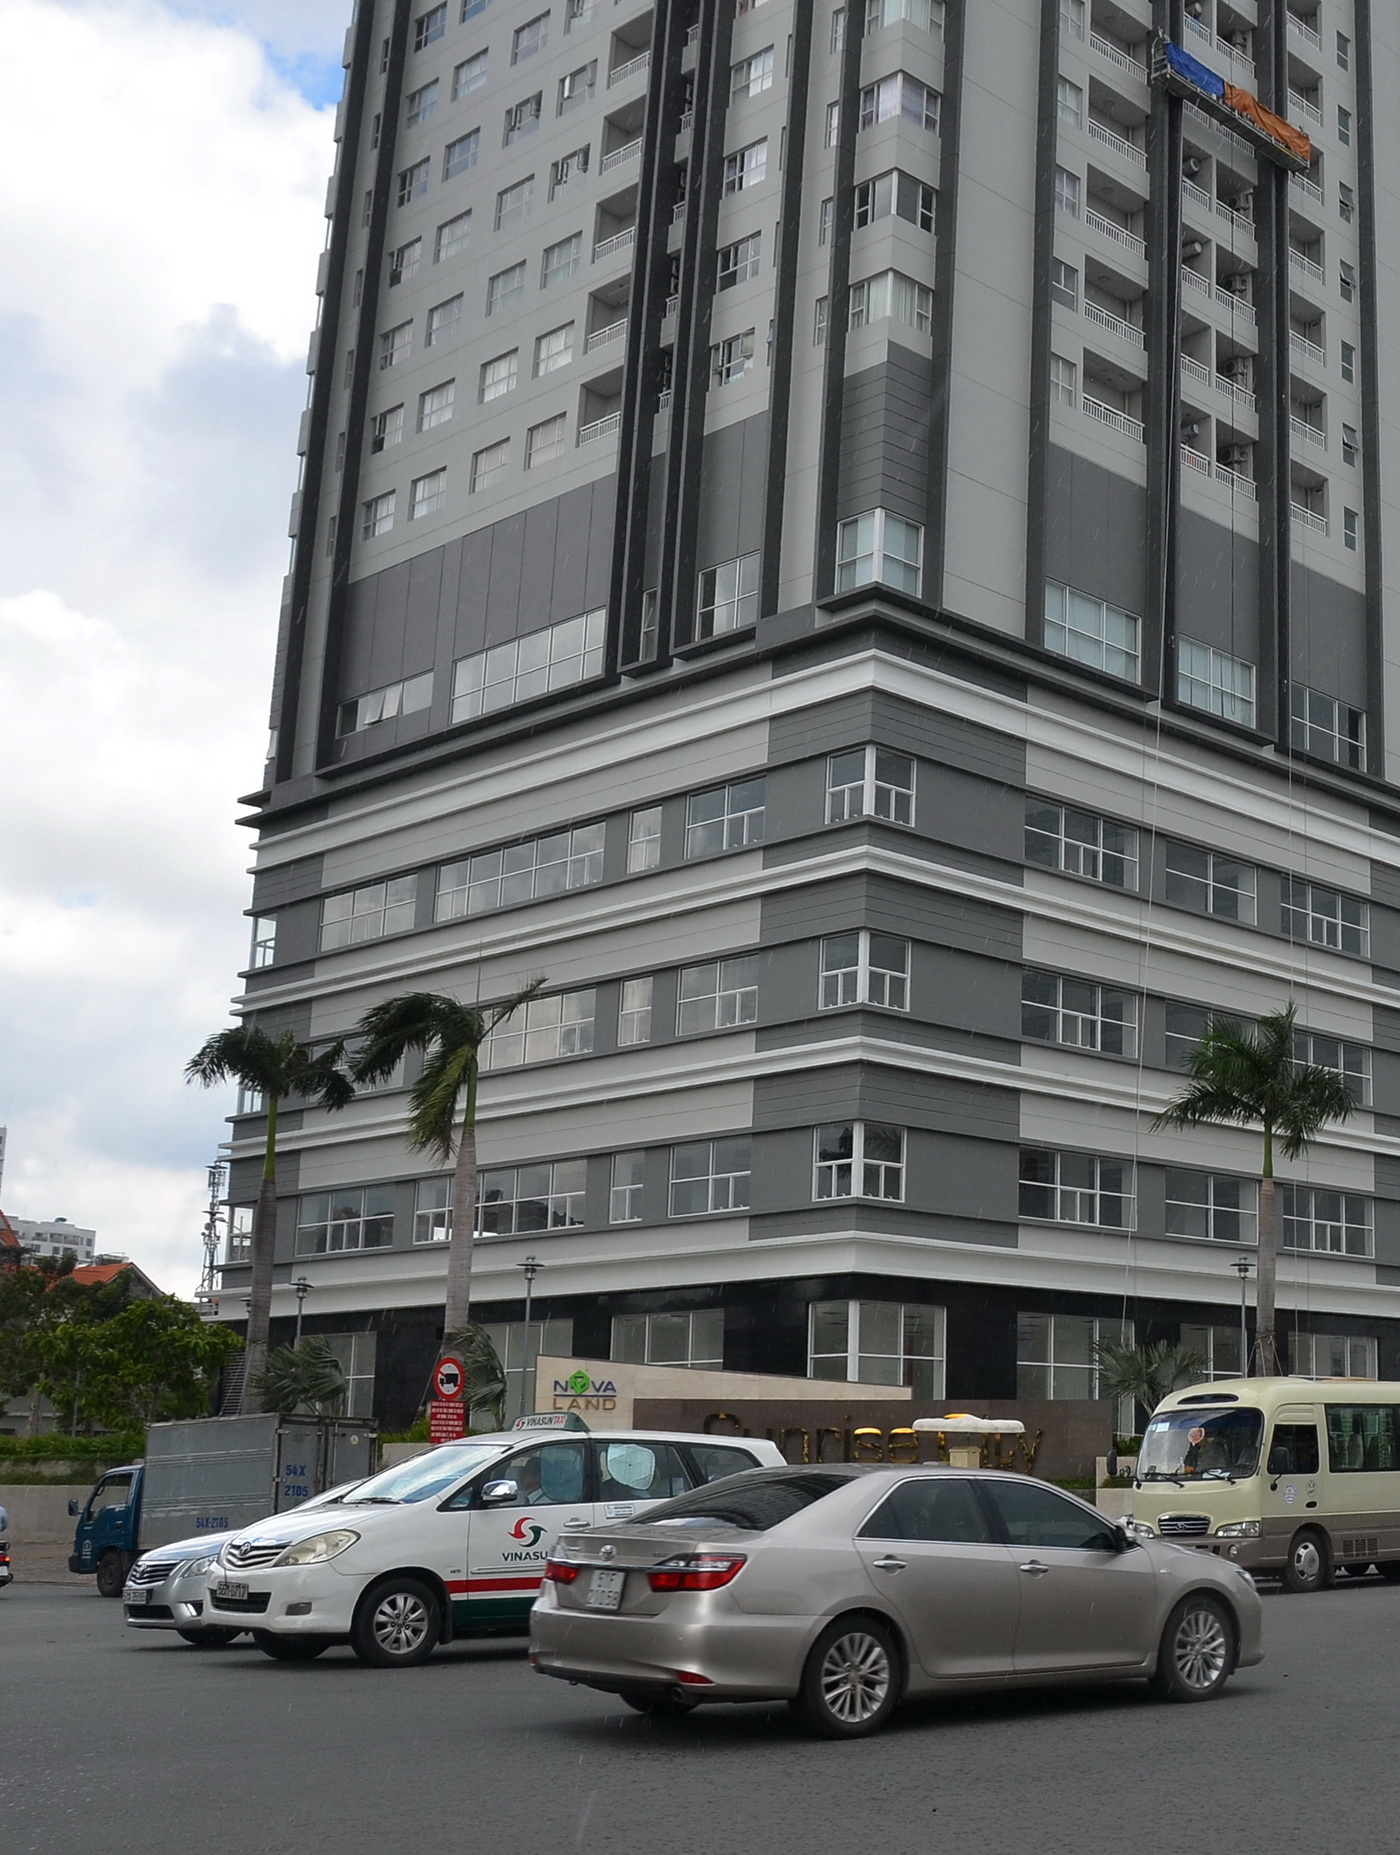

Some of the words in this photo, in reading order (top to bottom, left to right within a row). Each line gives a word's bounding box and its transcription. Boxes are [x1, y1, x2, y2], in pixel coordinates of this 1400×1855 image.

[553, 1398, 616, 1410] LAND
[526, 1416, 553, 1427] VINASUN
[703, 1413, 919, 1464] nrise
[285, 1464, 306, 1477] 54X
[284, 1485, 308, 1497] 2105
[195, 1517, 229, 1529] 54X-2105
[502, 1551, 549, 1562] VINASU
